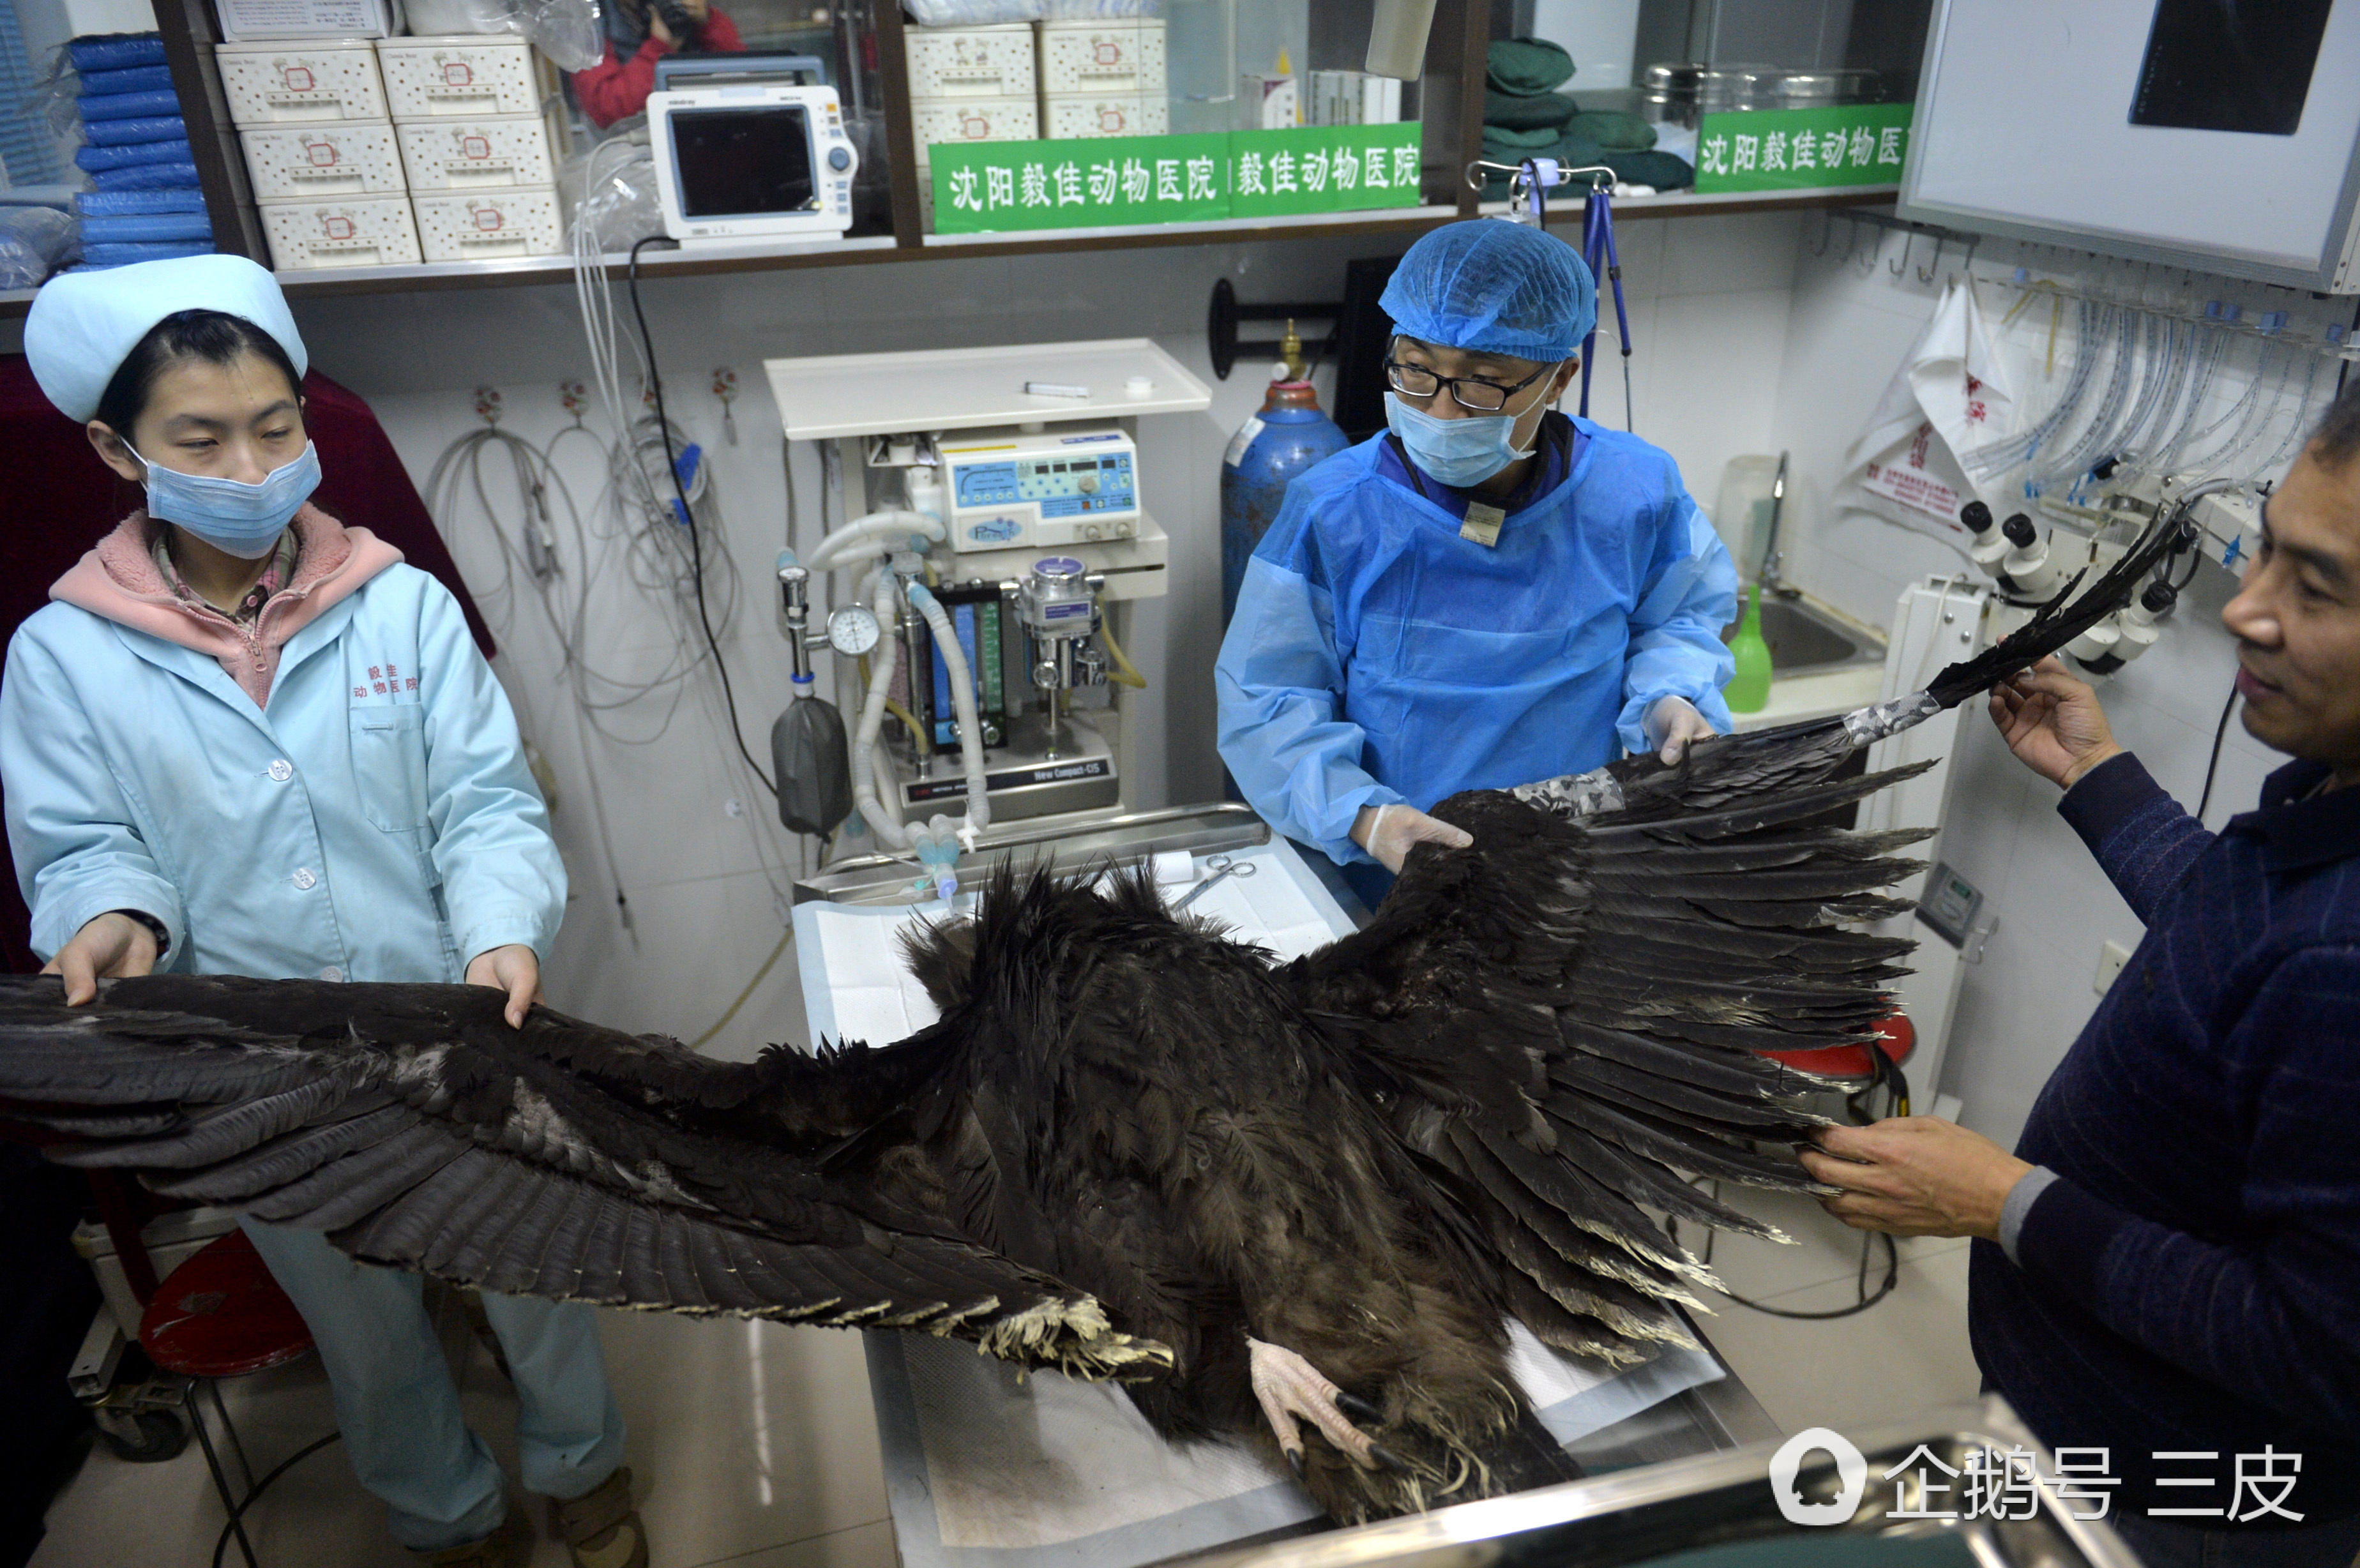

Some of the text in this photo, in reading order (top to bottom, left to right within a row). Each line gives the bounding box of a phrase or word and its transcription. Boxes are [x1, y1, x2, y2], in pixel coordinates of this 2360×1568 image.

[1237, 144, 1421, 195] 毅佳动物医院
[1701, 126, 1911, 176] 沈阳毅佳动物医
[949, 155, 1217, 212] 沈阳毅佳动物医院
[353, 677, 418, 698] 动物医院
